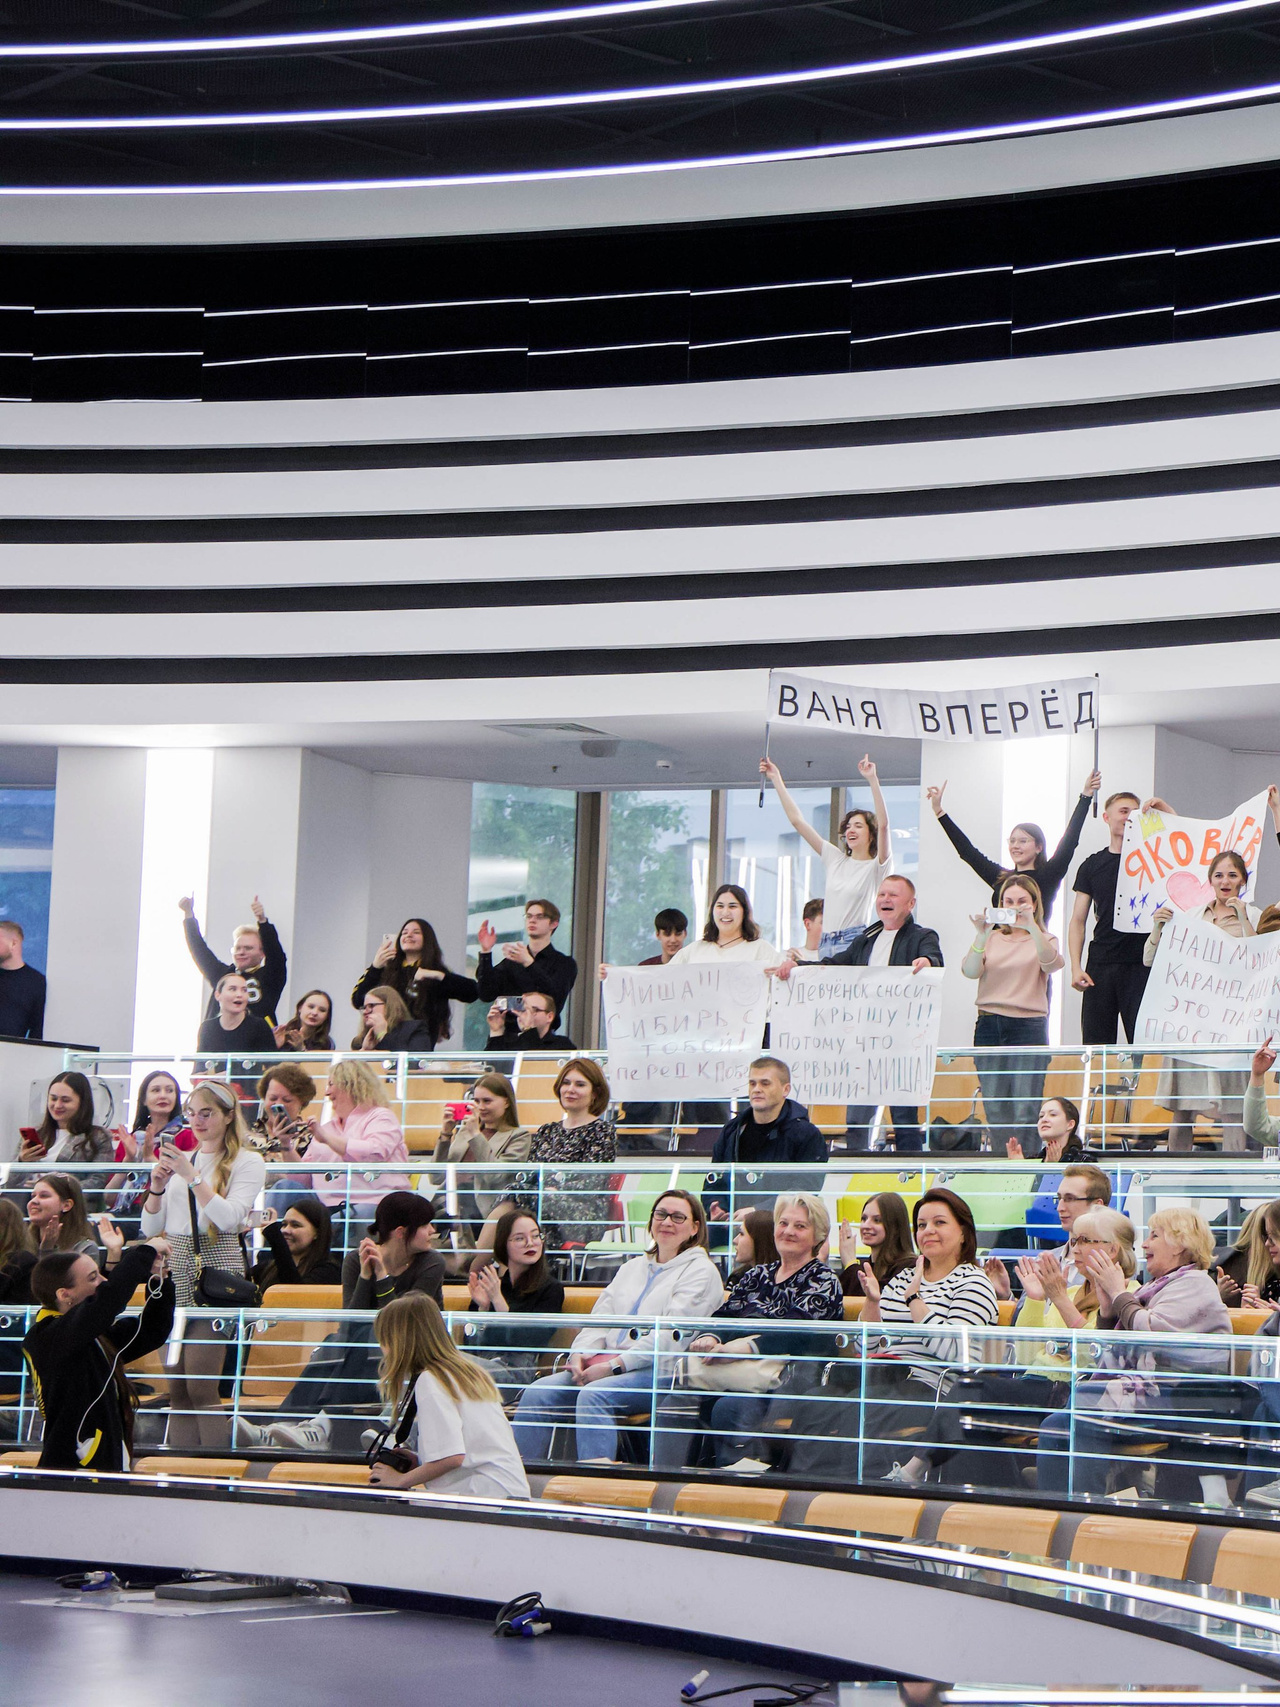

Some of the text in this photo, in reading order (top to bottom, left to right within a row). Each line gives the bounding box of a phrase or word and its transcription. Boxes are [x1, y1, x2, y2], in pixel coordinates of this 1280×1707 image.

[777, 684, 1096, 735] ВАНЯ ВПЕРЁД
[1168, 924, 1224, 965] НАШ
[1164, 995, 1210, 1019] ЭТО
[607, 1011, 728, 1040] СИБИРЬ
